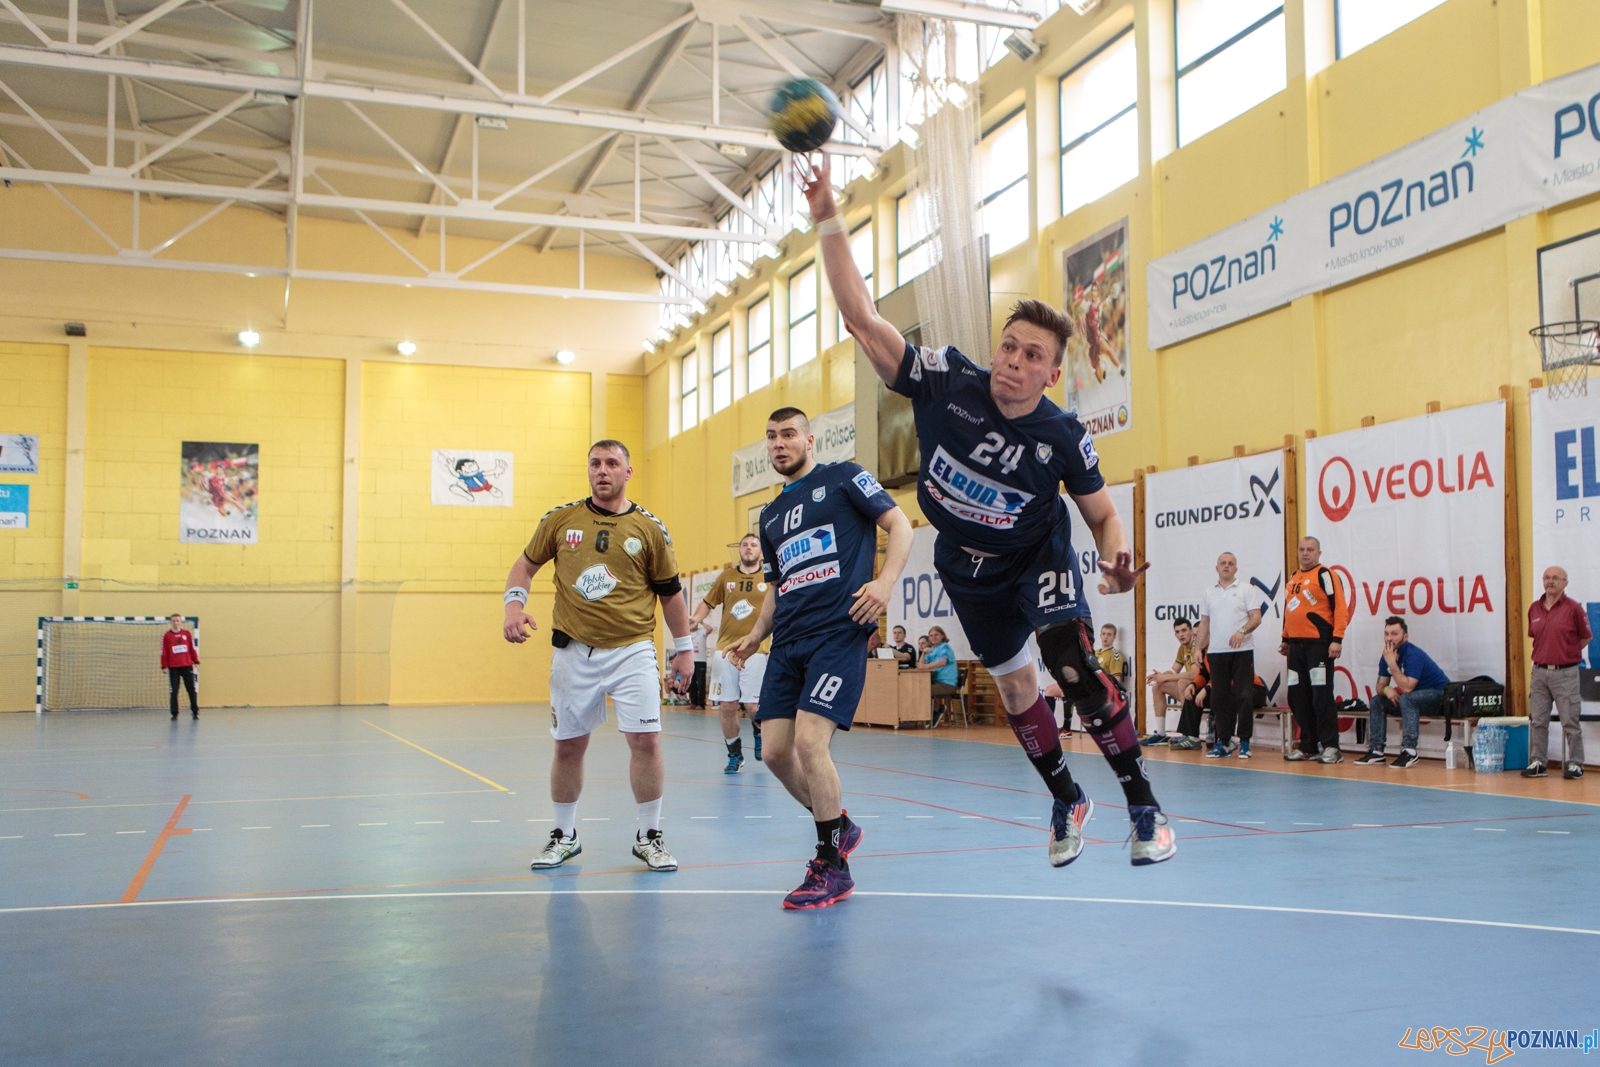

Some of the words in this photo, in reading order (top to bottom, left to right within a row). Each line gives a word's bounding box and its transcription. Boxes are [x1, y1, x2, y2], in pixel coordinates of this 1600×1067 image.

[1082, 407, 1115, 435] OZNAŃ
[968, 431, 1026, 475] 24
[931, 455, 998, 507] ELBUD
[1362, 451, 1495, 504] VEOLIA
[783, 503, 804, 535] 18
[1155, 500, 1250, 529] GRUNDFOS
[595, 529, 610, 553] 6
[582, 573, 606, 587] Polski
[585, 582, 612, 594] Cukier
[739, 580, 753, 593] 18
[1037, 569, 1076, 608] 24
[1362, 574, 1494, 616] VEOLIA
[1155, 604, 1200, 620] GRUN
[810, 672, 843, 702] 18
